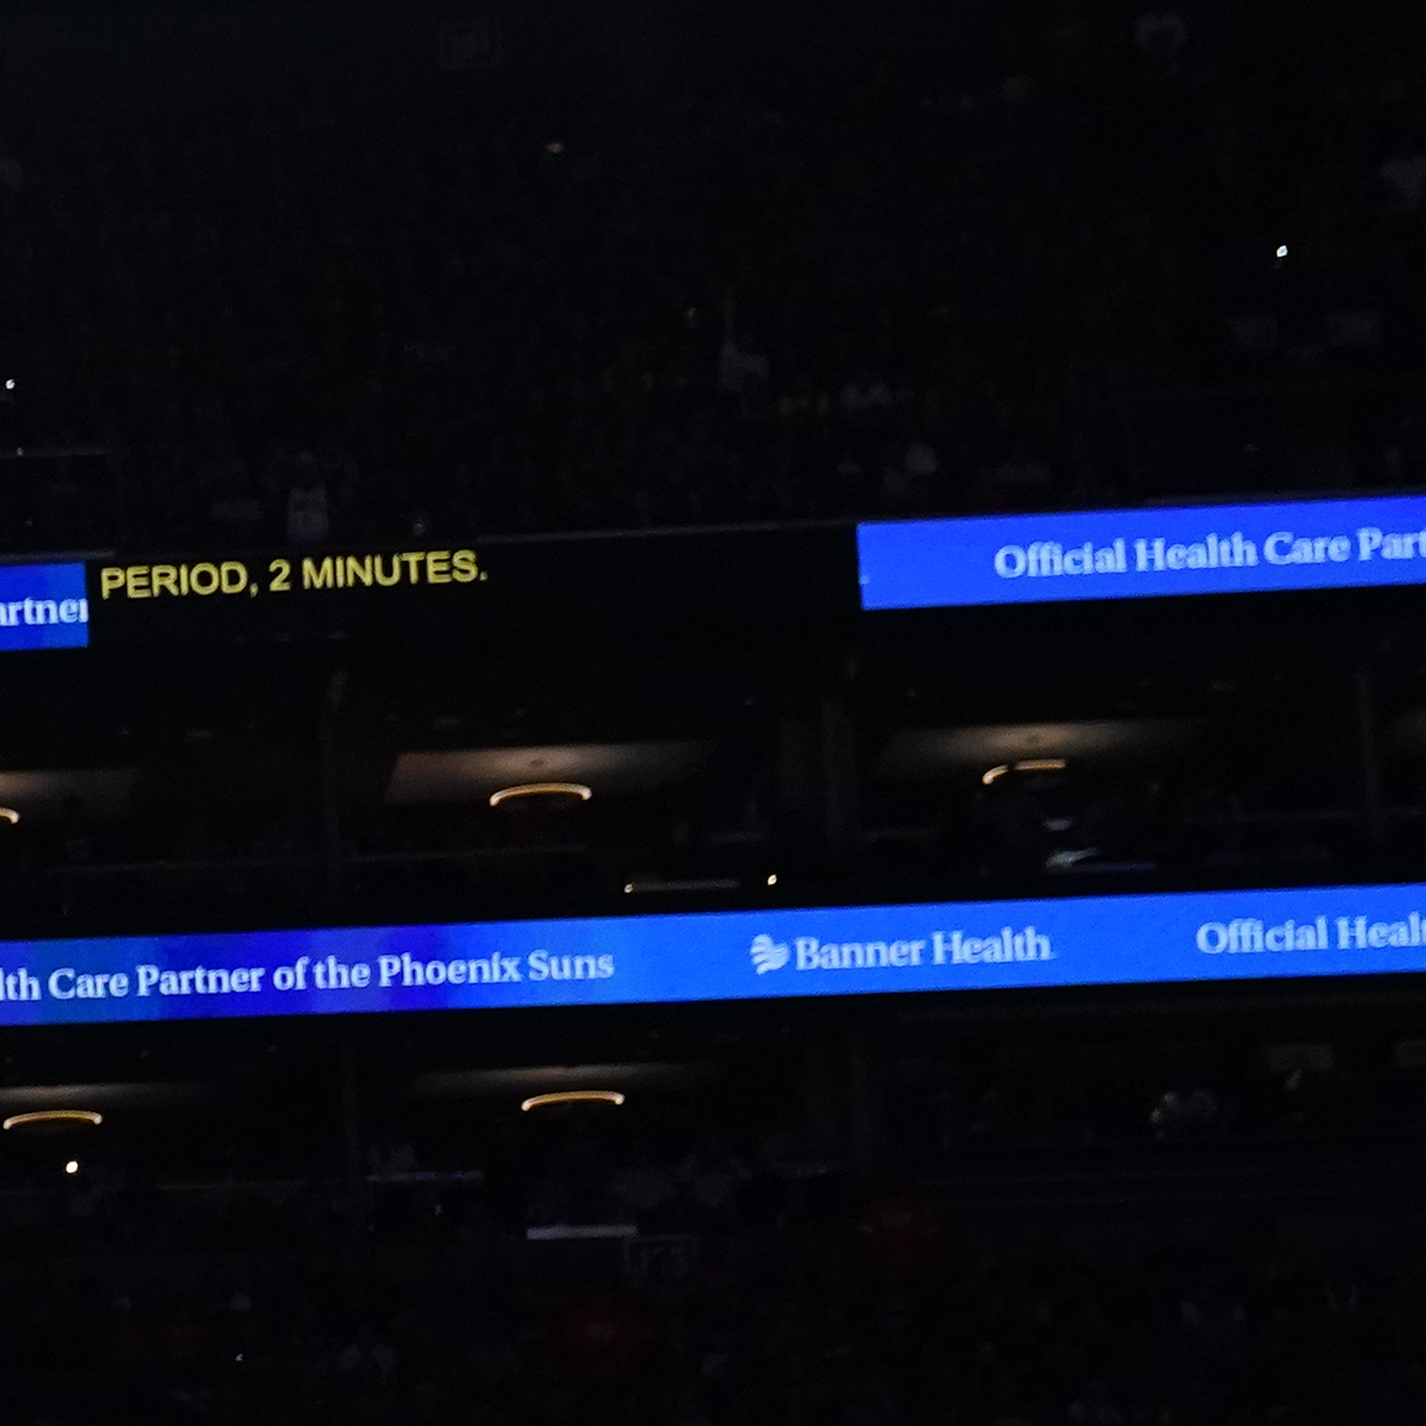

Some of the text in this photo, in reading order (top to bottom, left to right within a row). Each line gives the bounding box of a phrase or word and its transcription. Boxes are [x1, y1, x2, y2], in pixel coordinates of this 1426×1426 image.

[101, 549, 488, 600] PERIOD, 2 MINUTES.
[995, 538, 1127, 580] Official
[1135, 531, 1258, 573] Health
[1264, 530, 1351, 566] Care
[796, 926, 1052, 970] Banner Health
[1196, 916, 1329, 955] Official
[48, 967, 129, 999] Care
[137, 961, 264, 997] Partner
[273, 956, 312, 991] of
[315, 956, 370, 989] the
[378, 950, 520, 987] Phoenix
[528, 949, 614, 984] Suns
